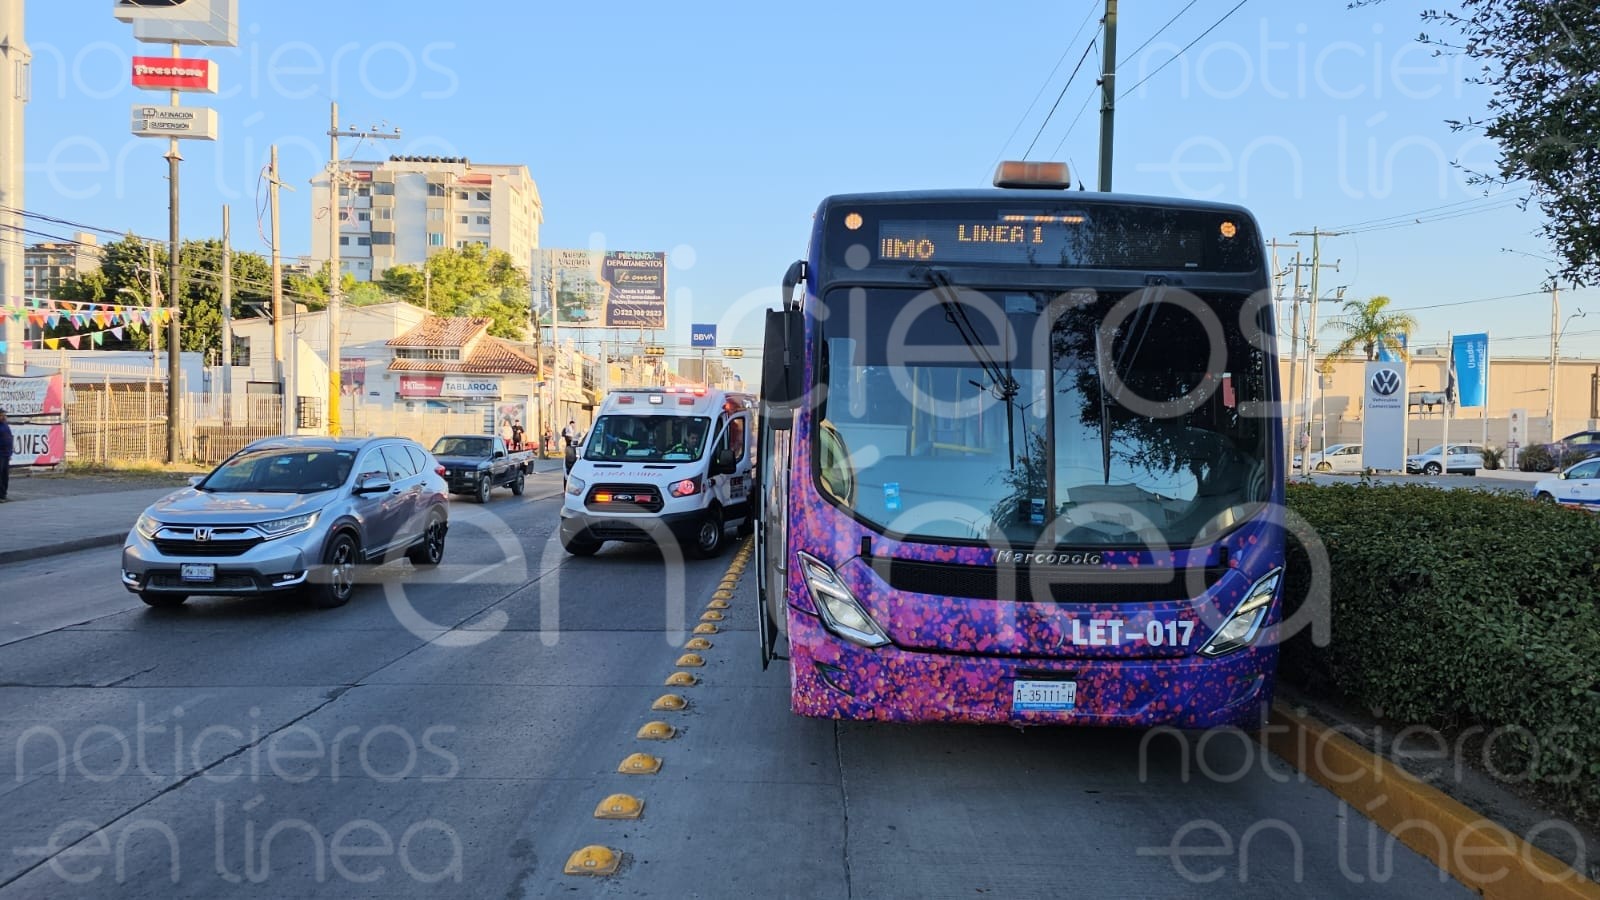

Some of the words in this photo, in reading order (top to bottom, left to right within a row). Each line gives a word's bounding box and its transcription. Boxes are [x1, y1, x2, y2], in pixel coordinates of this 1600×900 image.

[134, 64, 204, 77] Firestone
[958, 224, 1024, 243] LINEA
[1032, 226, 1043, 243] 1
[693, 333, 714, 341] BBVA
[446, 383, 498, 391] TABLAROCA
[996, 549, 1102, 566] Marcopolo
